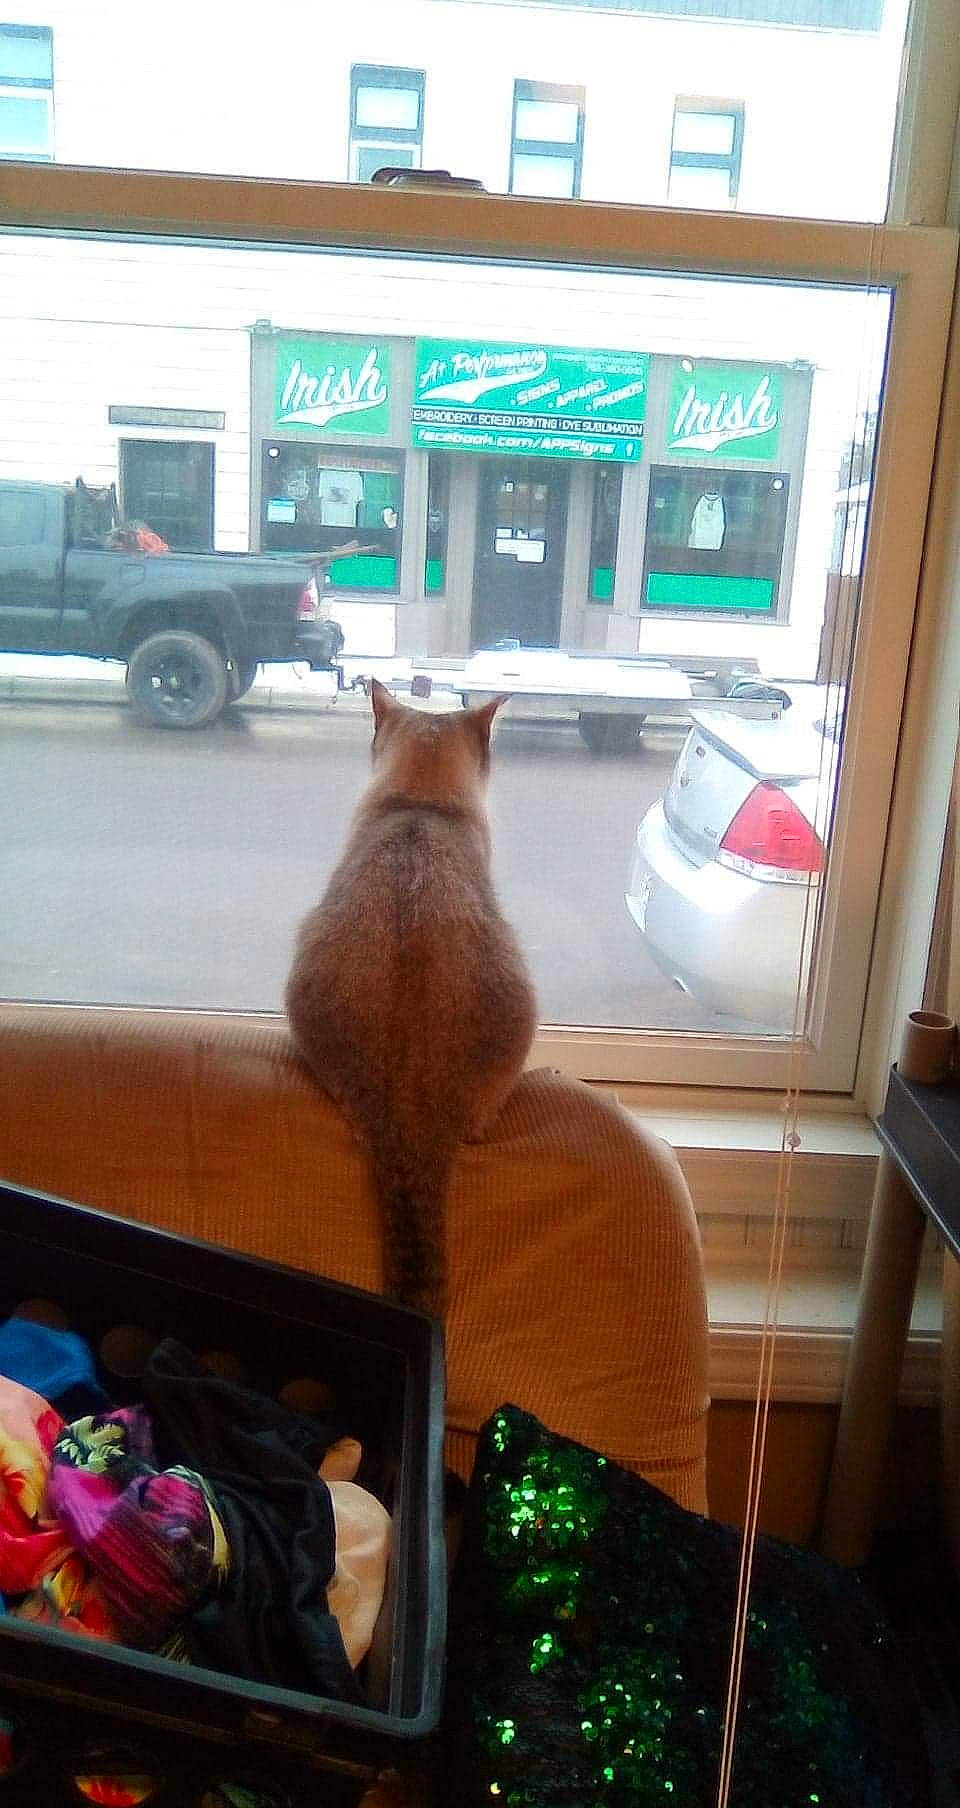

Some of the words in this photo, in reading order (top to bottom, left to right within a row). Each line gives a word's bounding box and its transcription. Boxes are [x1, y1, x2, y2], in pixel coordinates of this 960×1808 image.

[279, 347, 388, 424] Irish
[516, 376, 561, 406] SIGNS
[671, 374, 779, 440] Irish
[413, 409, 473, 424] EMBROIDERY
[478, 413, 516, 427] SCREEN
[516, 416, 557, 430] PRINTING
[562, 419, 583, 431] DYE
[583, 421, 644, 436] SUBLIMATION
